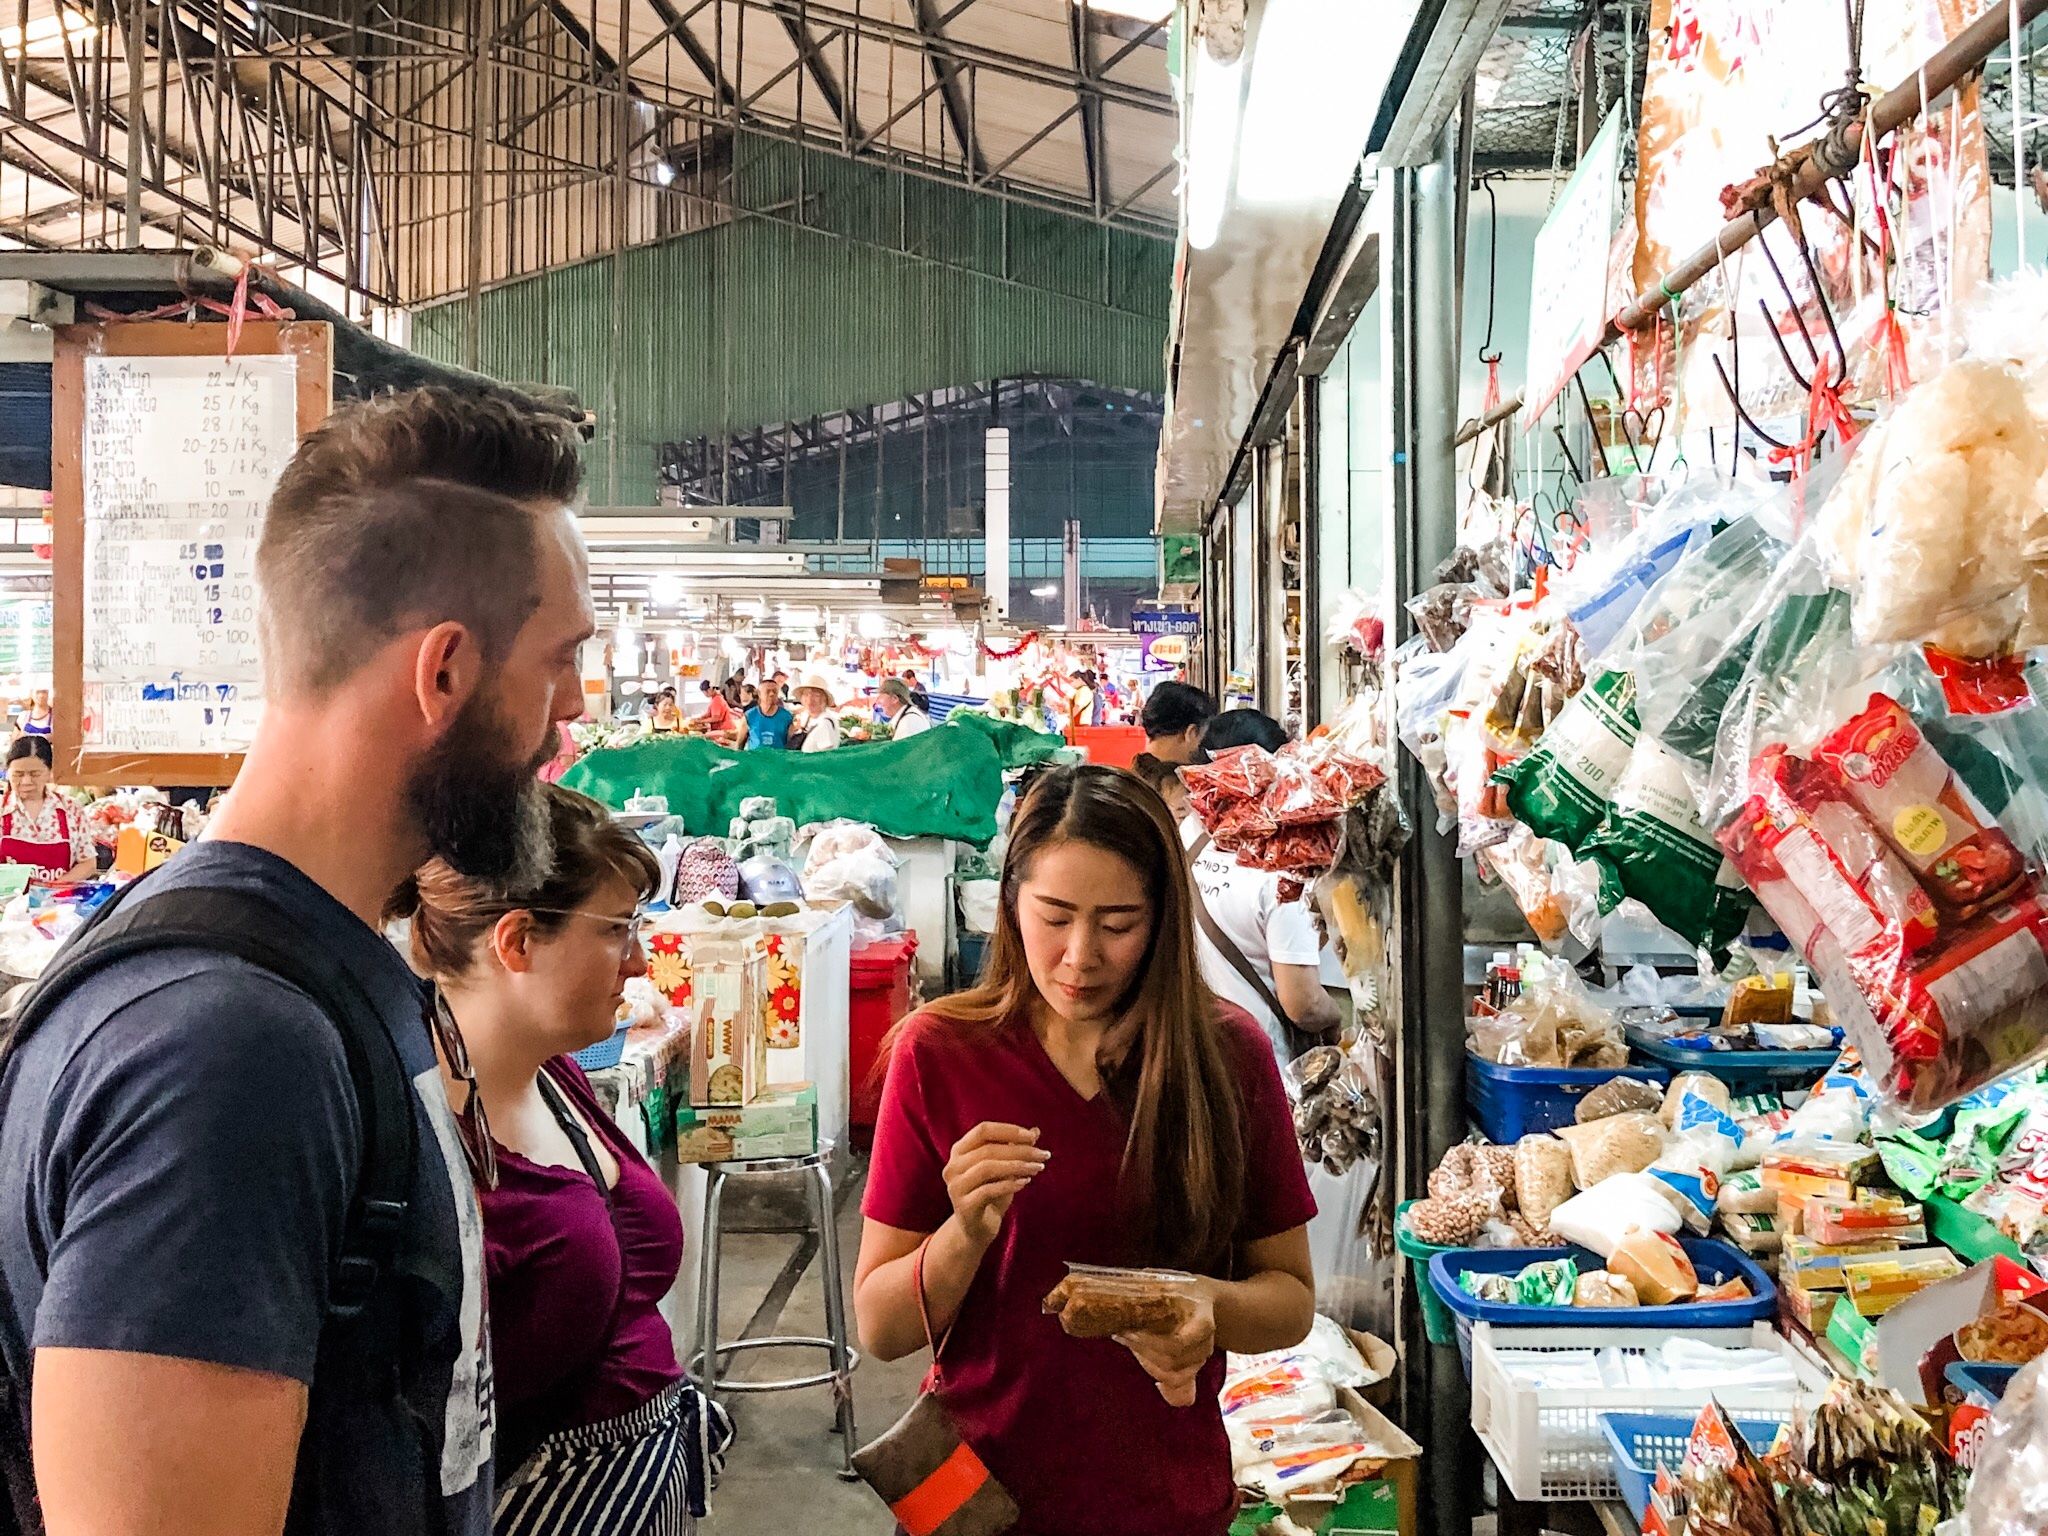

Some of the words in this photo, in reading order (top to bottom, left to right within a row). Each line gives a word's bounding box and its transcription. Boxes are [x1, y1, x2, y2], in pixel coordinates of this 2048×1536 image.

[206, 372, 221, 387] 22
[203, 396, 220, 411] 25
[202, 416, 220, 432] 28
[205, 481, 220, 497] 10
[180, 543, 197, 559] 25
[1132, 614, 1198, 633] ทางเข้า-ออก
[1576, 755, 1605, 783] 200
[723, 1019, 732, 1055] MAMA
[707, 1114, 743, 1125] MAMA
